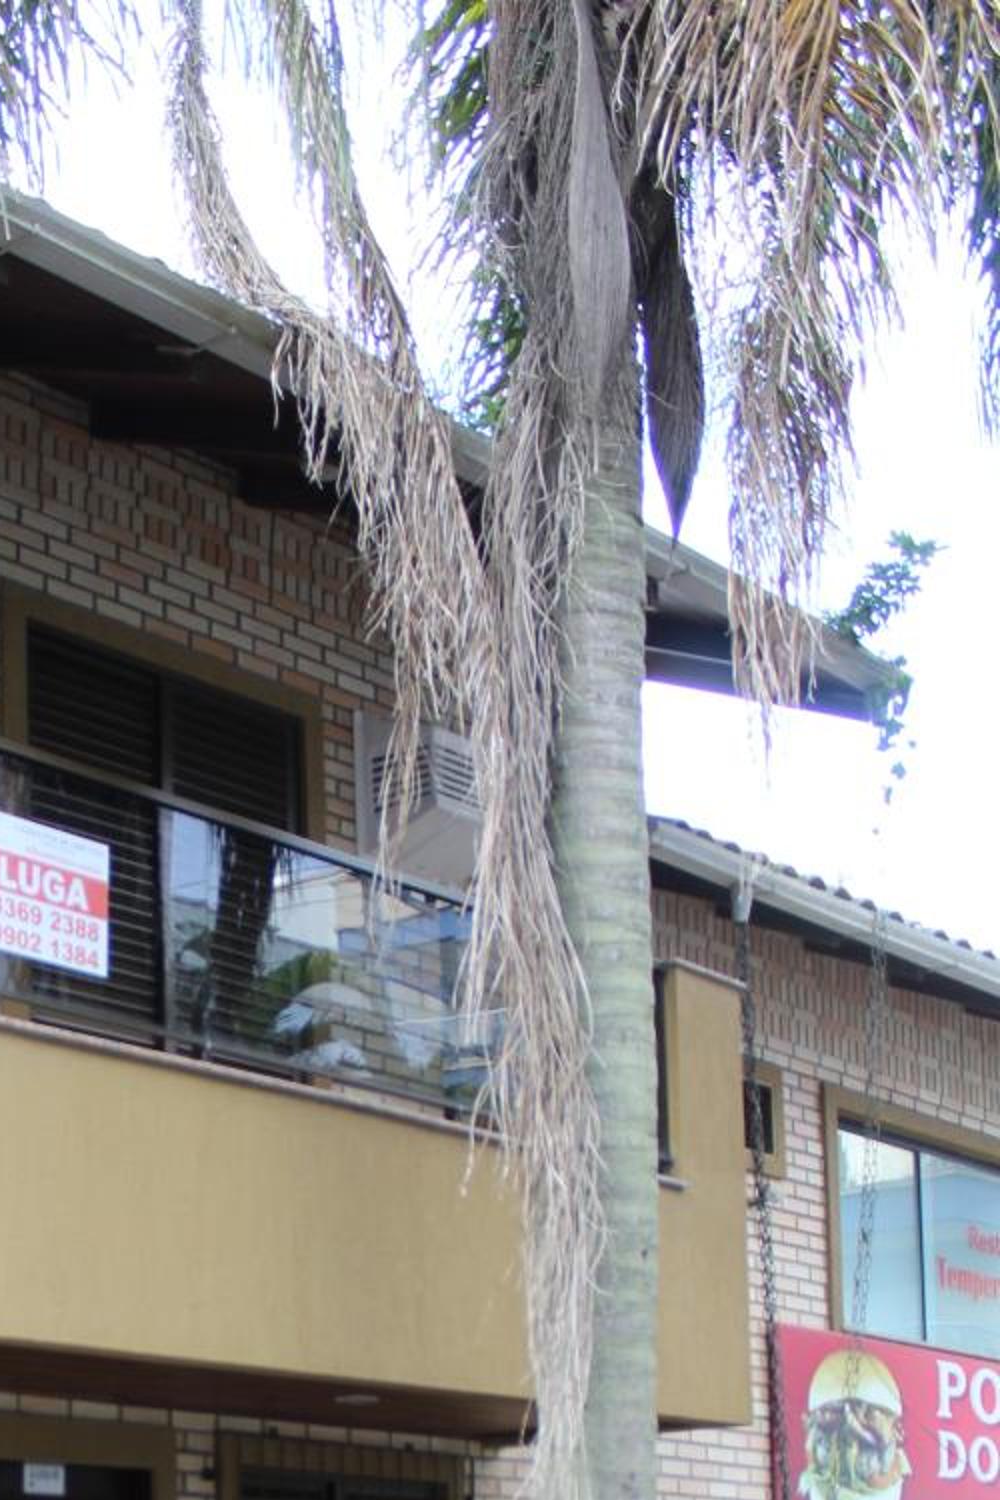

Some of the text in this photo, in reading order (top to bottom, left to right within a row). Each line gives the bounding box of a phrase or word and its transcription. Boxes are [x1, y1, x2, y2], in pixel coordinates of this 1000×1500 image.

[50, 911, 99, 943] 2388
[51, 938, 99, 968] 1384
[936, 1359, 1000, 1425] PO
[937, 1429, 1000, 1484] DO
